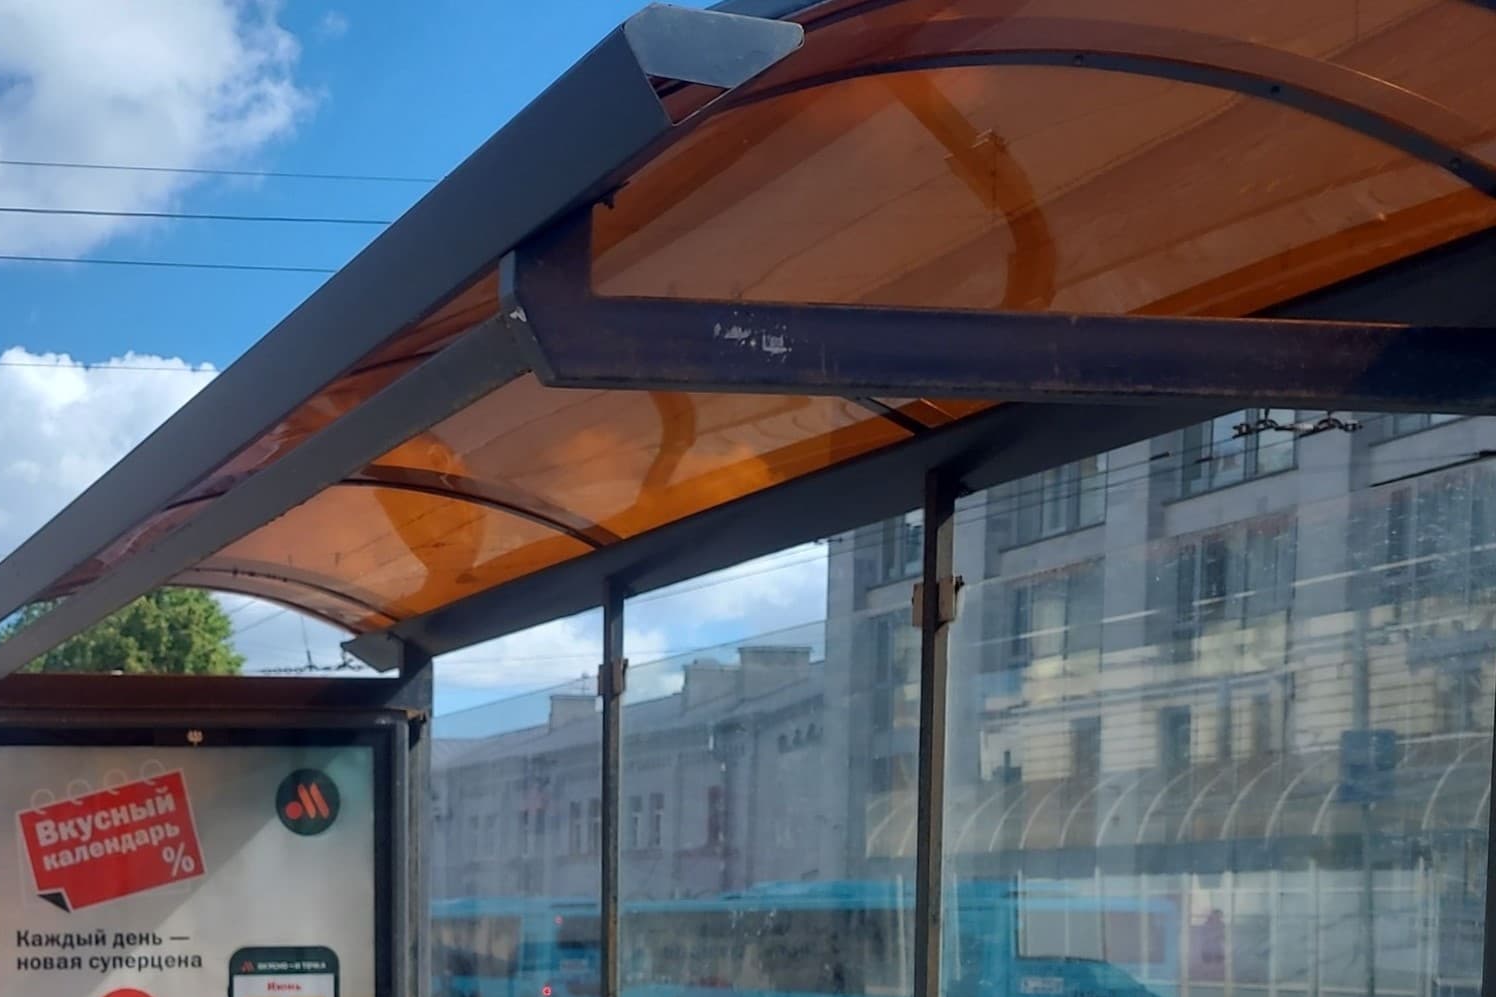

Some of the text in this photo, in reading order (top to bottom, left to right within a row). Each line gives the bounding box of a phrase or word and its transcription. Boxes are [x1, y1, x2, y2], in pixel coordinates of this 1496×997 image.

[35, 786, 176, 847] Вкусный
[43, 822, 180, 871] календарь
[162, 843, 195, 877] %
[17, 929, 106, 949] Каждый
[112, 931, 162, 948] день
[17, 954, 203, 973] новая суперцена
